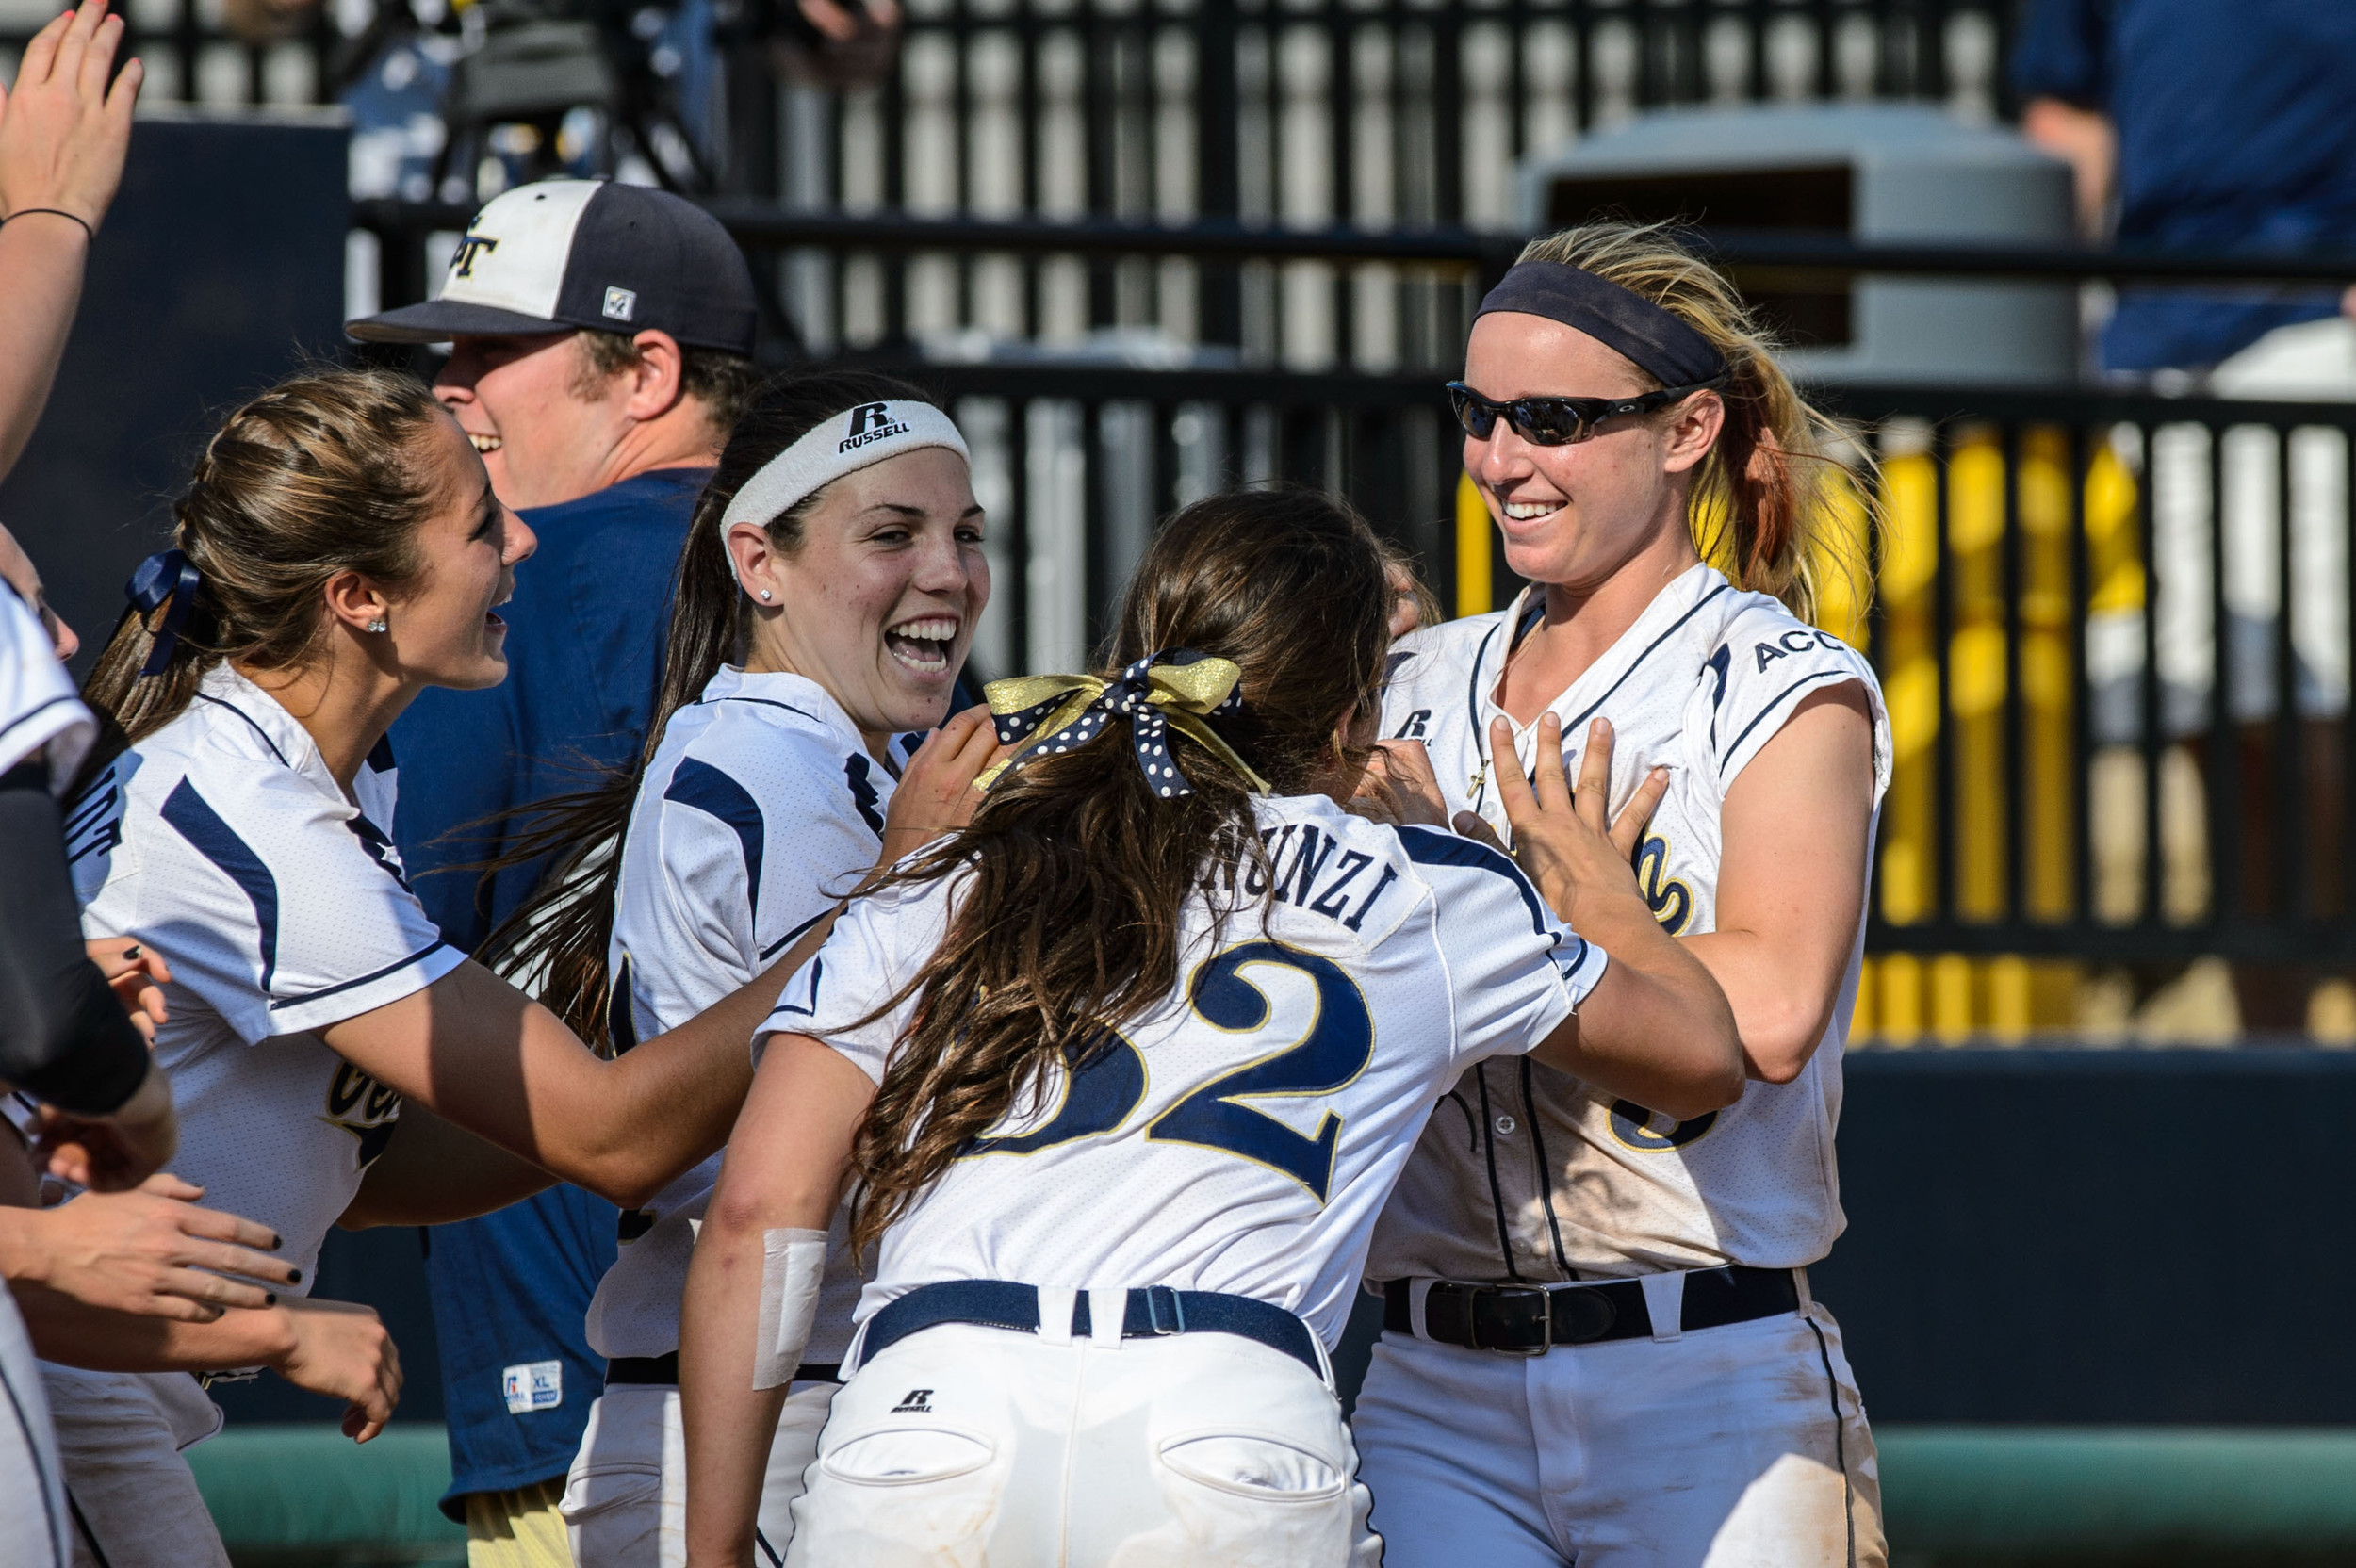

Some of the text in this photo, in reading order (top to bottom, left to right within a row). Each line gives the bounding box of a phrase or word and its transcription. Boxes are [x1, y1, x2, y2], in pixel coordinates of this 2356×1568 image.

[849, 402, 889, 438] R
[838, 422, 910, 454] RUSSELL
[1755, 630, 1845, 674] ACC
[533, 1375, 549, 1390] XL
[900, 1389, 935, 1405] R
